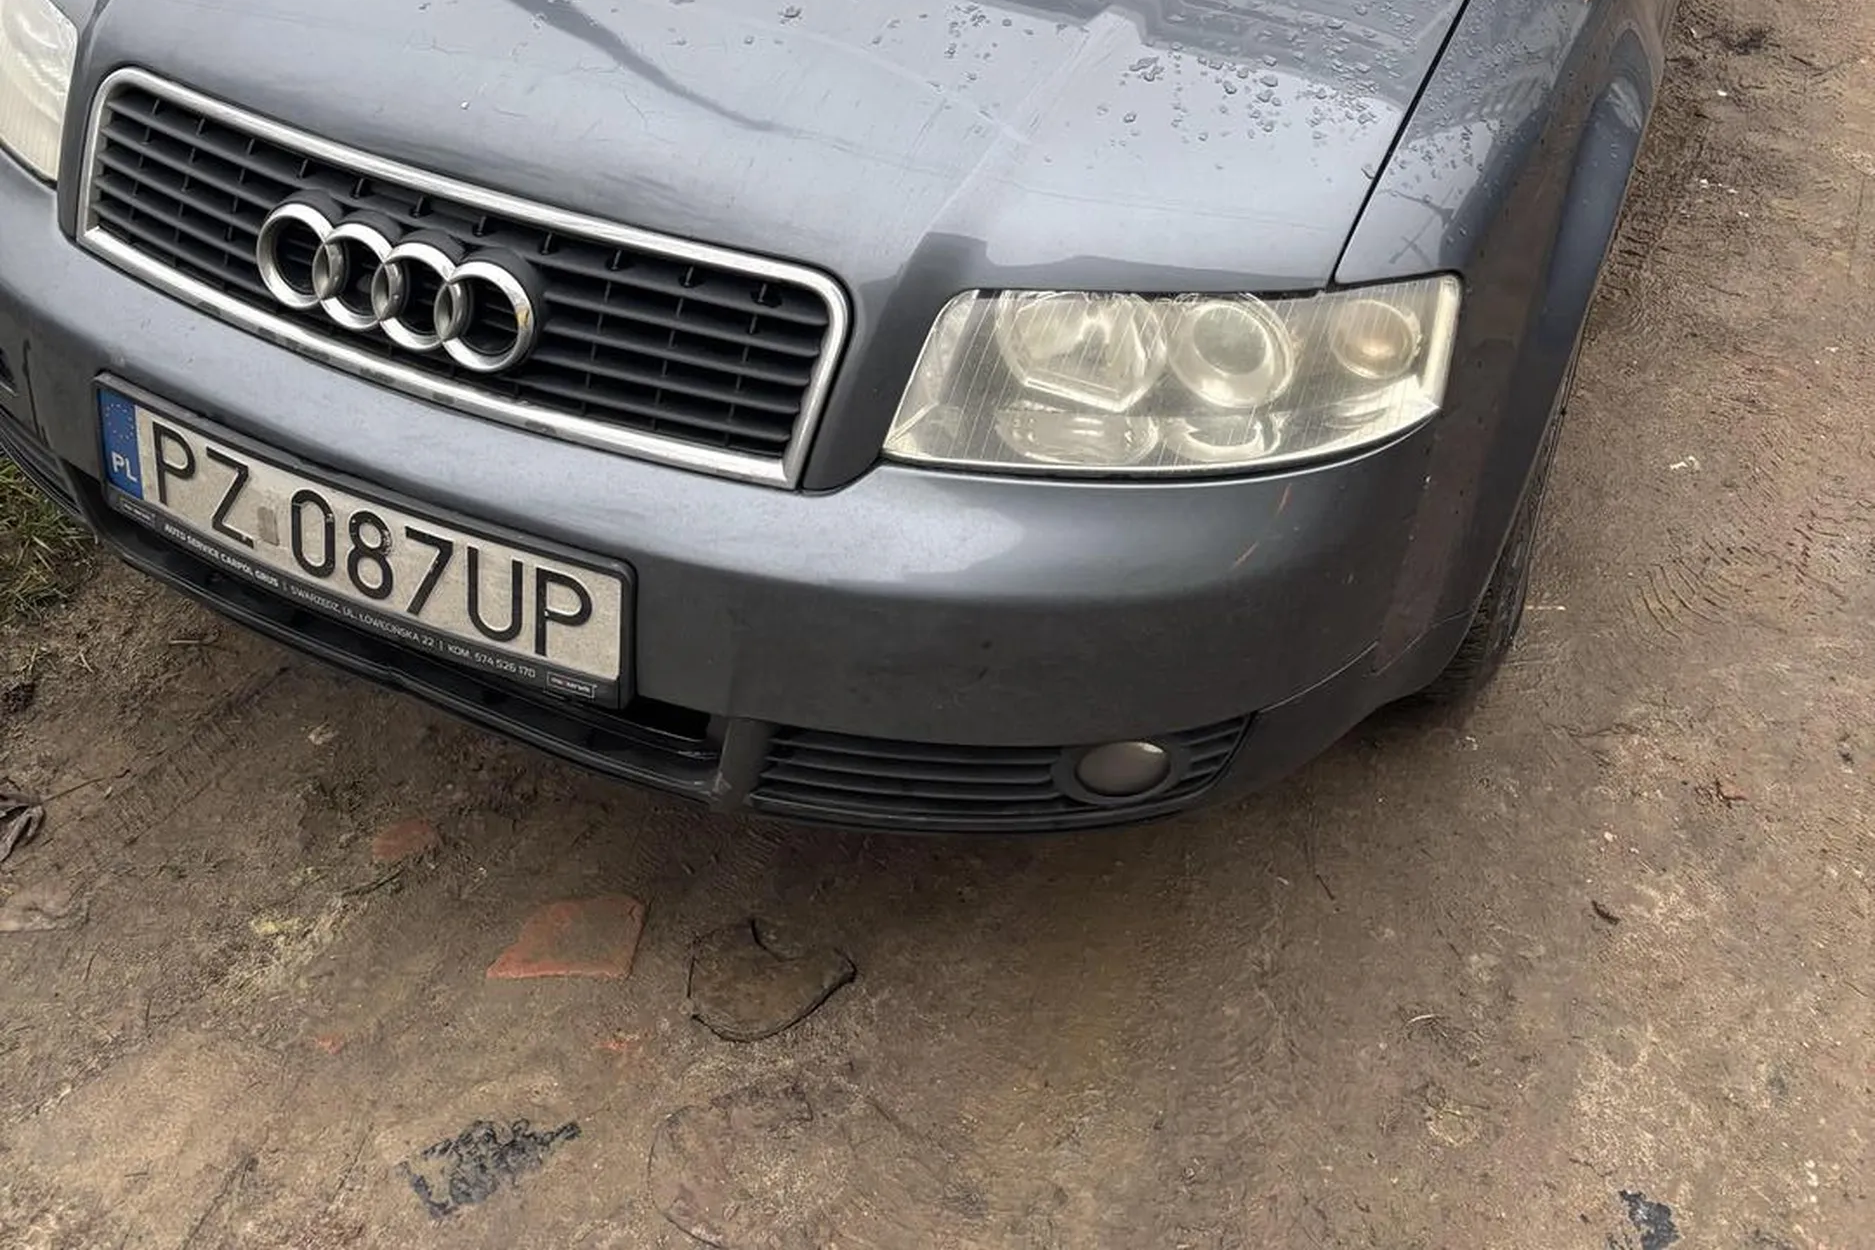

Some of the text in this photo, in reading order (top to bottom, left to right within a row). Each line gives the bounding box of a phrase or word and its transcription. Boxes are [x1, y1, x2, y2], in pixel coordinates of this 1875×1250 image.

[112, 452, 137, 483] PL
[152, 421, 592, 655] PZ 087UP
[164, 523, 186, 541] AUTO
[187, 535, 220, 560] SERVICE
[422, 634, 435, 647] 22
